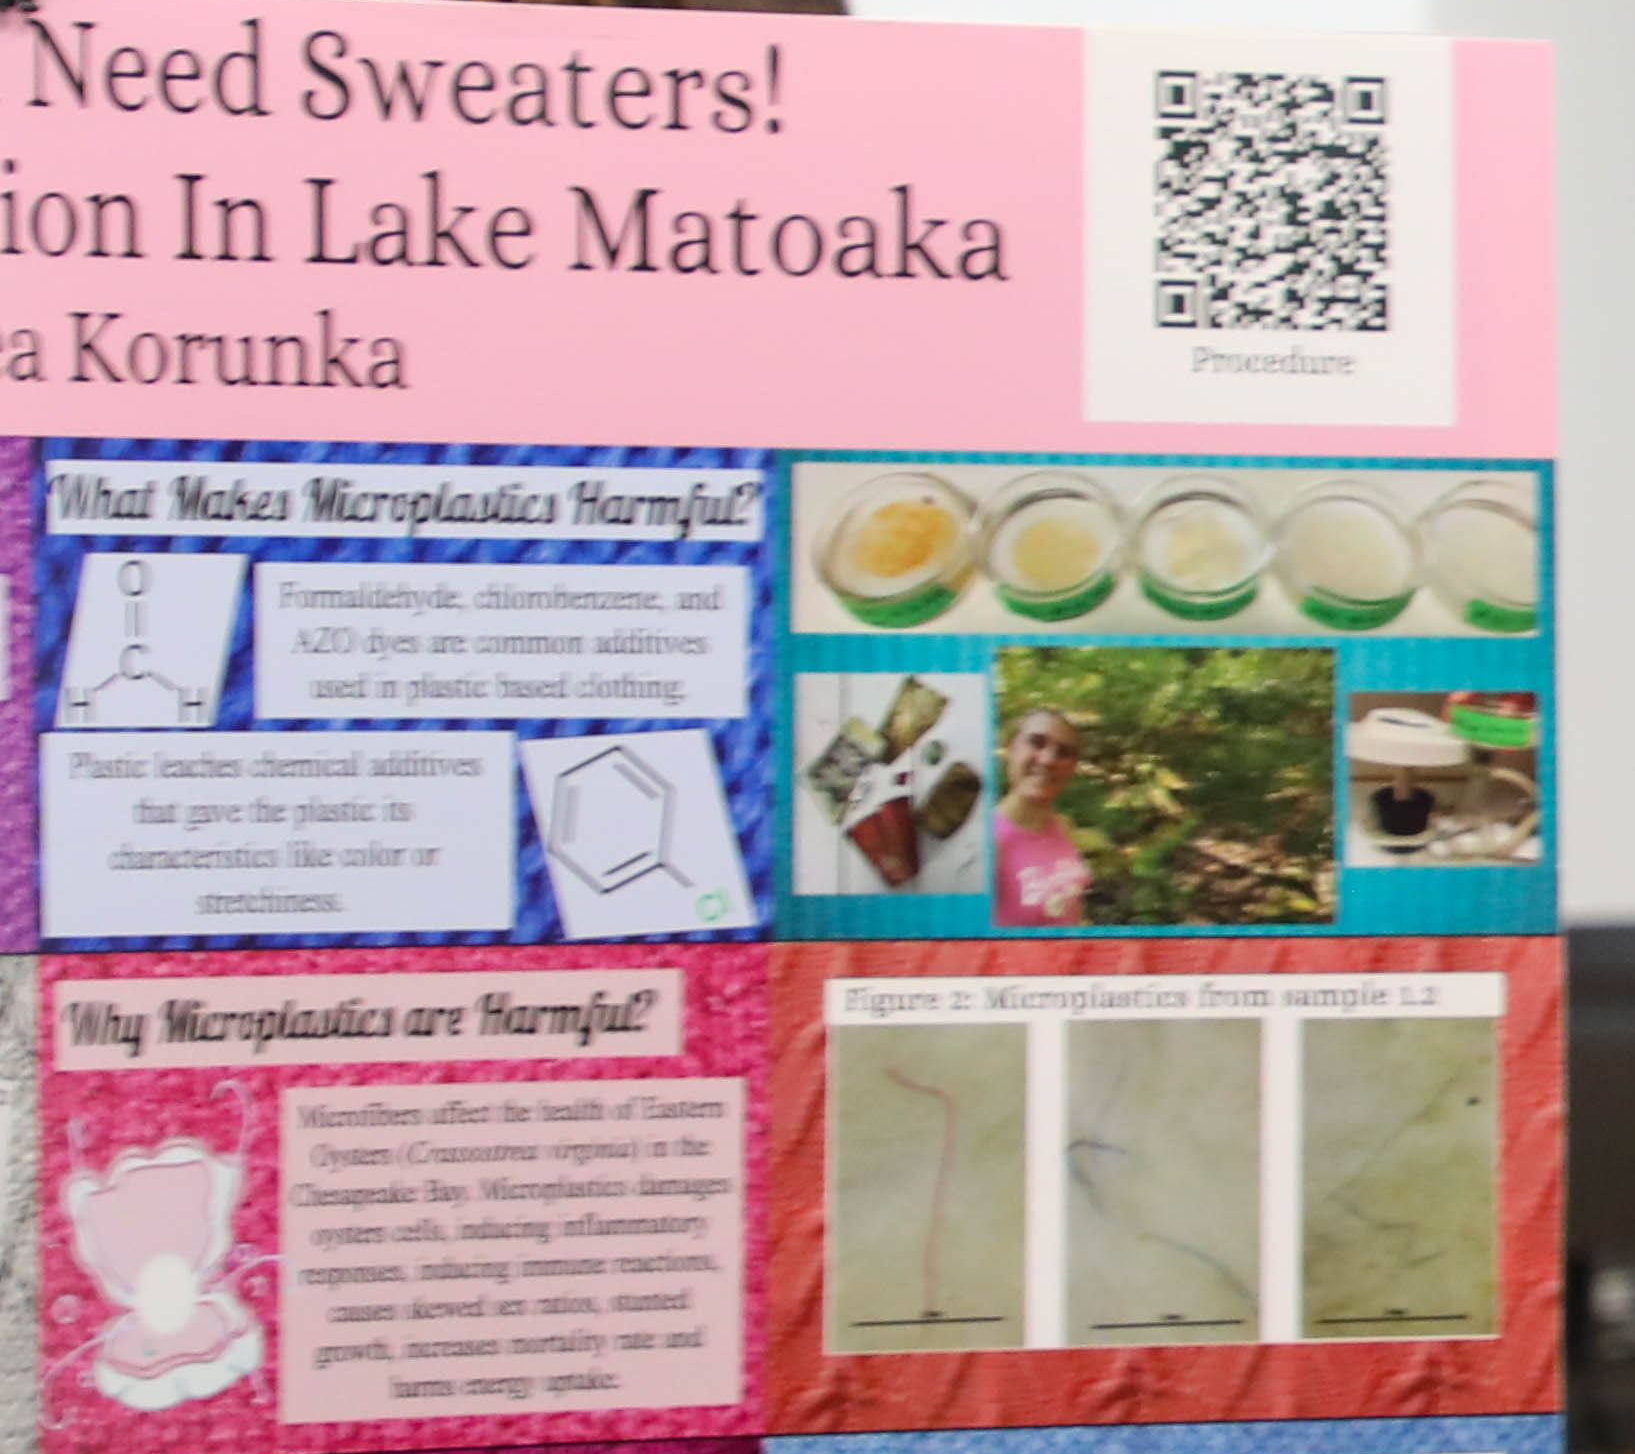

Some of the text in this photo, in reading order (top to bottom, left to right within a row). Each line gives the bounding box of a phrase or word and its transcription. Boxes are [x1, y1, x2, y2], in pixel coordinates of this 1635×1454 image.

[26, 17, 784, 135] Need Sweaters!
[174, 173, 274, 263] In
[304, 170, 537, 271] Lake
[566, 184, 1011, 281] Matoaka
[67, 308, 411, 390] Korunka
[1191, 344, 1357, 375] Procedure
[48, 473, 763, 540] What Makes Microplastics Harmful?
[116, 559, 154, 597] O
[279, 580, 471, 617] Formaldehyde,
[672, 583, 727, 611] and
[119, 643, 151, 680] C
[290, 626, 710, 662] AZO dyes are common additives
[309, 671, 371, 699] used
[374, 671, 398, 698] in
[404, 670, 490, 707] plastic
[495, 670, 569, 699] based
[68, 748, 486, 779] Plastic leaches chemical additives
[131, 796, 181, 824] that
[182, 804, 246, 831] gave
[248, 796, 289, 823] the
[292, 795, 377, 831] plastic
[106, 839, 442, 871] characteristics like color or
[844, 985, 941, 1018] Figure
[982, 981, 1187, 1015] Microplastics
[1197, 979, 1272, 1009] from
[1279, 980, 1390, 1014] sample
[61, 988, 661, 1058] Why Microplastics are Harmful?
